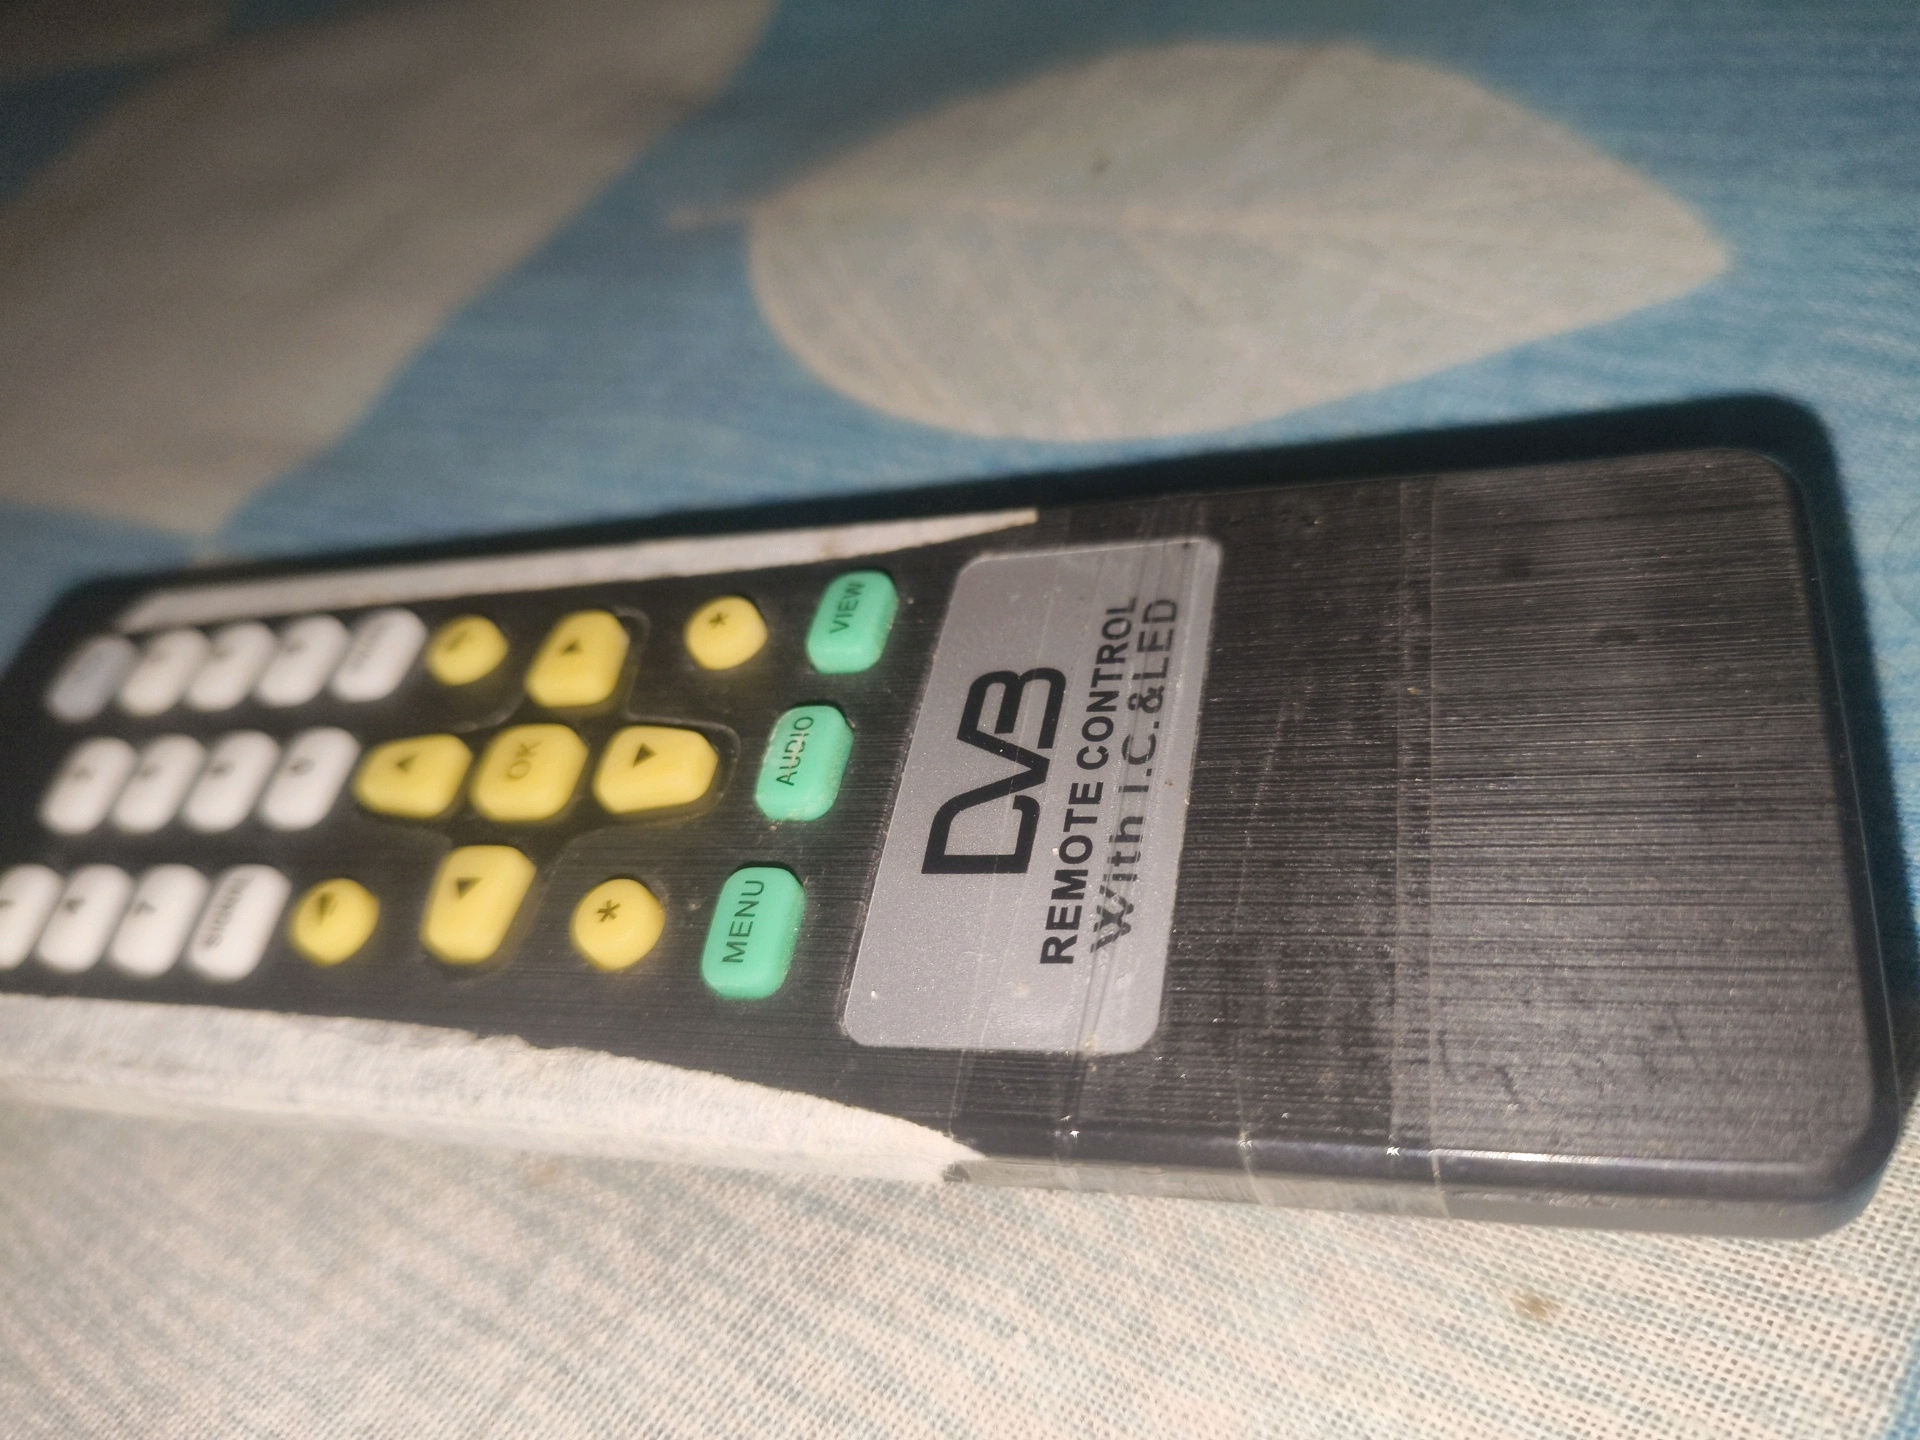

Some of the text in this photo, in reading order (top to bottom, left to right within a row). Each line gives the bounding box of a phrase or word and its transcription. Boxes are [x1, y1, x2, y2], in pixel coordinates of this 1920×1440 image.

[830, 581, 866, 634] VIEW
[507, 740, 543, 780] OK
[776, 716, 814, 786] AUDIO
[922, 667, 1066, 874] DVB
[1040, 597, 1135, 963] REMOTE CONTROL
[722, 880, 764, 963] MENU
[1090, 816, 1144, 953] With
